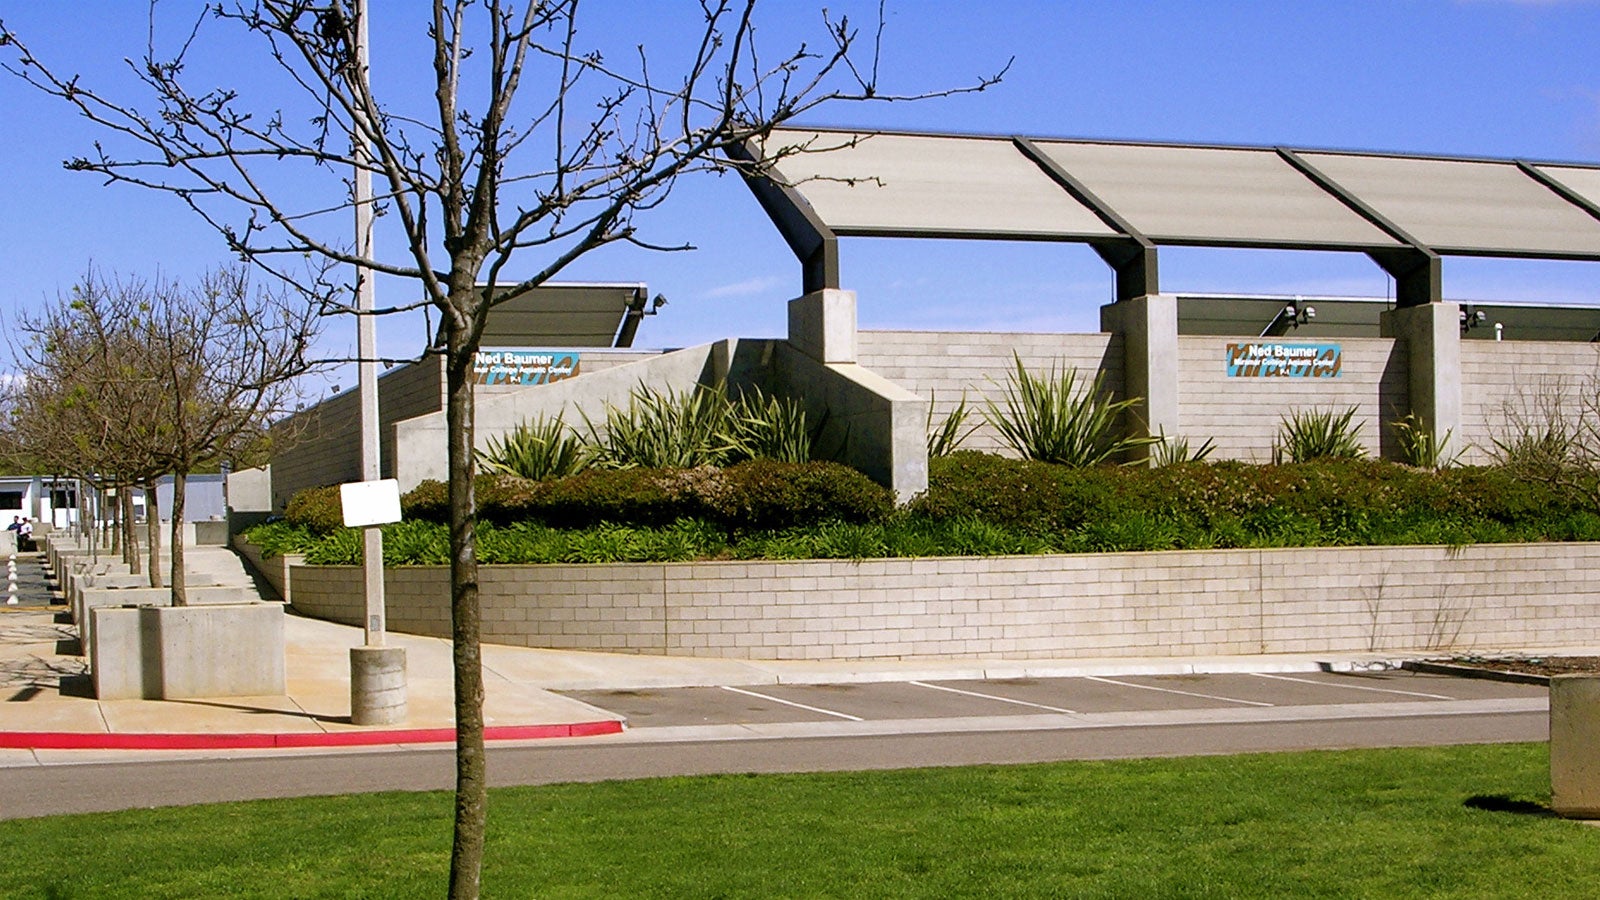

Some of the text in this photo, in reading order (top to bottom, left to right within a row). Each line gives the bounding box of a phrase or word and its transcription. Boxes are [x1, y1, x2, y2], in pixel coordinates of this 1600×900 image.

[1249, 345, 1318, 357] Ned Baumer
[475, 352, 553, 364] Ned Baumer
[1262, 359, 1287, 367] College
[1288, 358, 1312, 366] Aquatic
[1313, 358, 1335, 366] Center
[490, 366, 518, 375] College
[519, 366, 547, 375] Aquatic
[548, 366, 572, 375] Center
